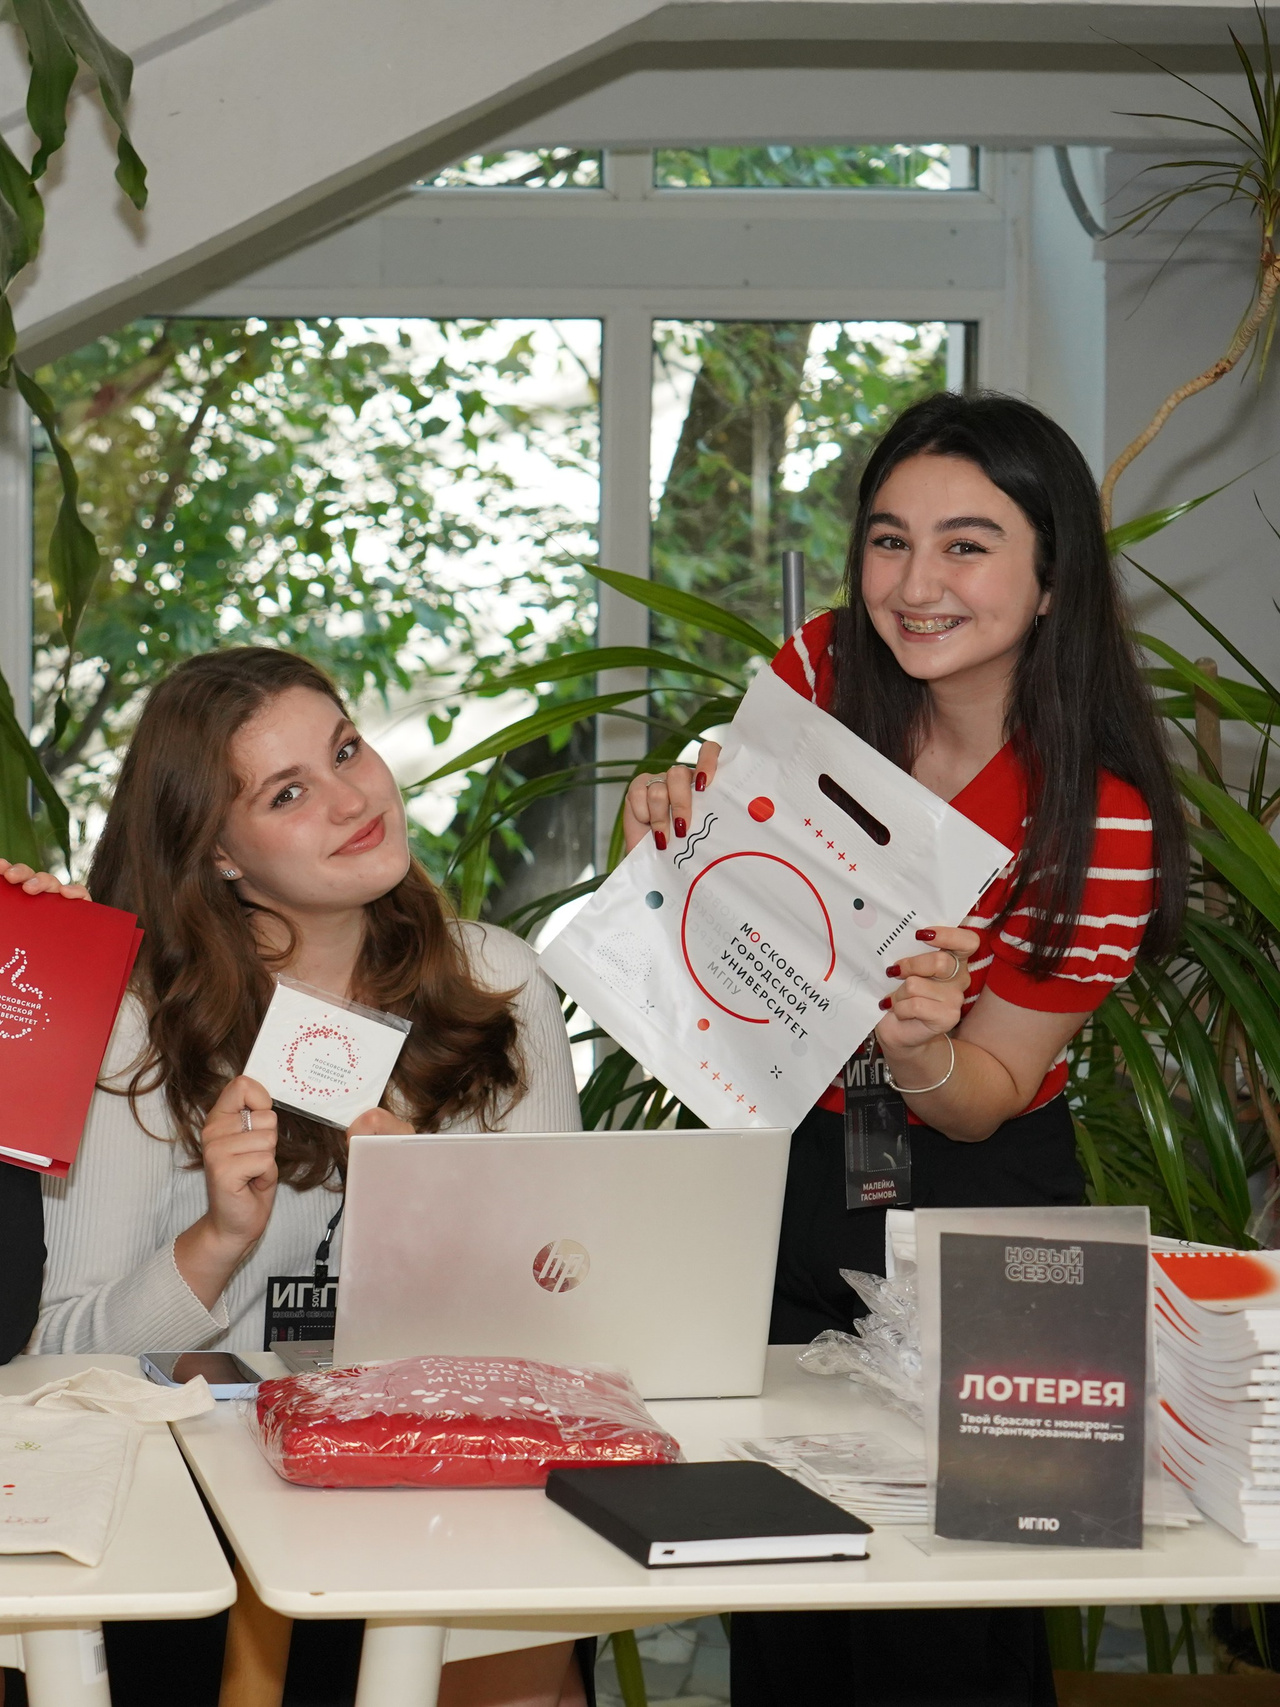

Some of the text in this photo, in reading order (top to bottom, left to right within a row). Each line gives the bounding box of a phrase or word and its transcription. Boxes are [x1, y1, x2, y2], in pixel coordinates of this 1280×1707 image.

[730, 936, 808, 1015] ГОРОДСКОЙ
[740, 922, 830, 1012] МОСКОВСКИЙ
[707, 961, 742, 995] МГПУ
[720, 950, 808, 1040] УНИВЕРСИТЕТ
[312, 1063, 345, 1079] ГОРОДСКОЙ
[314, 1058, 352, 1074] МОСКОВСКИЙ
[310, 1069, 347, 1086] УНИВЕРСИТЕТ
[862, 1179, 895, 1191] МАЛЕЙКА
[860, 1190, 897, 1202] ГАСЫМОВА
[1005, 1246, 1084, 1267] НОВЫЙ
[1005, 1263, 1084, 1285] СЕЗОН
[958, 1374, 1126, 1407] ЛОТЕРЕЯ
[960, 1413, 991, 1425] Твой
[993, 1414, 1042, 1428] браслет
[1043, 1419, 1052, 1428] с
[1054, 1420, 1110, 1432] номером
[959, 1424, 1125, 1442] это гарантированный приз
